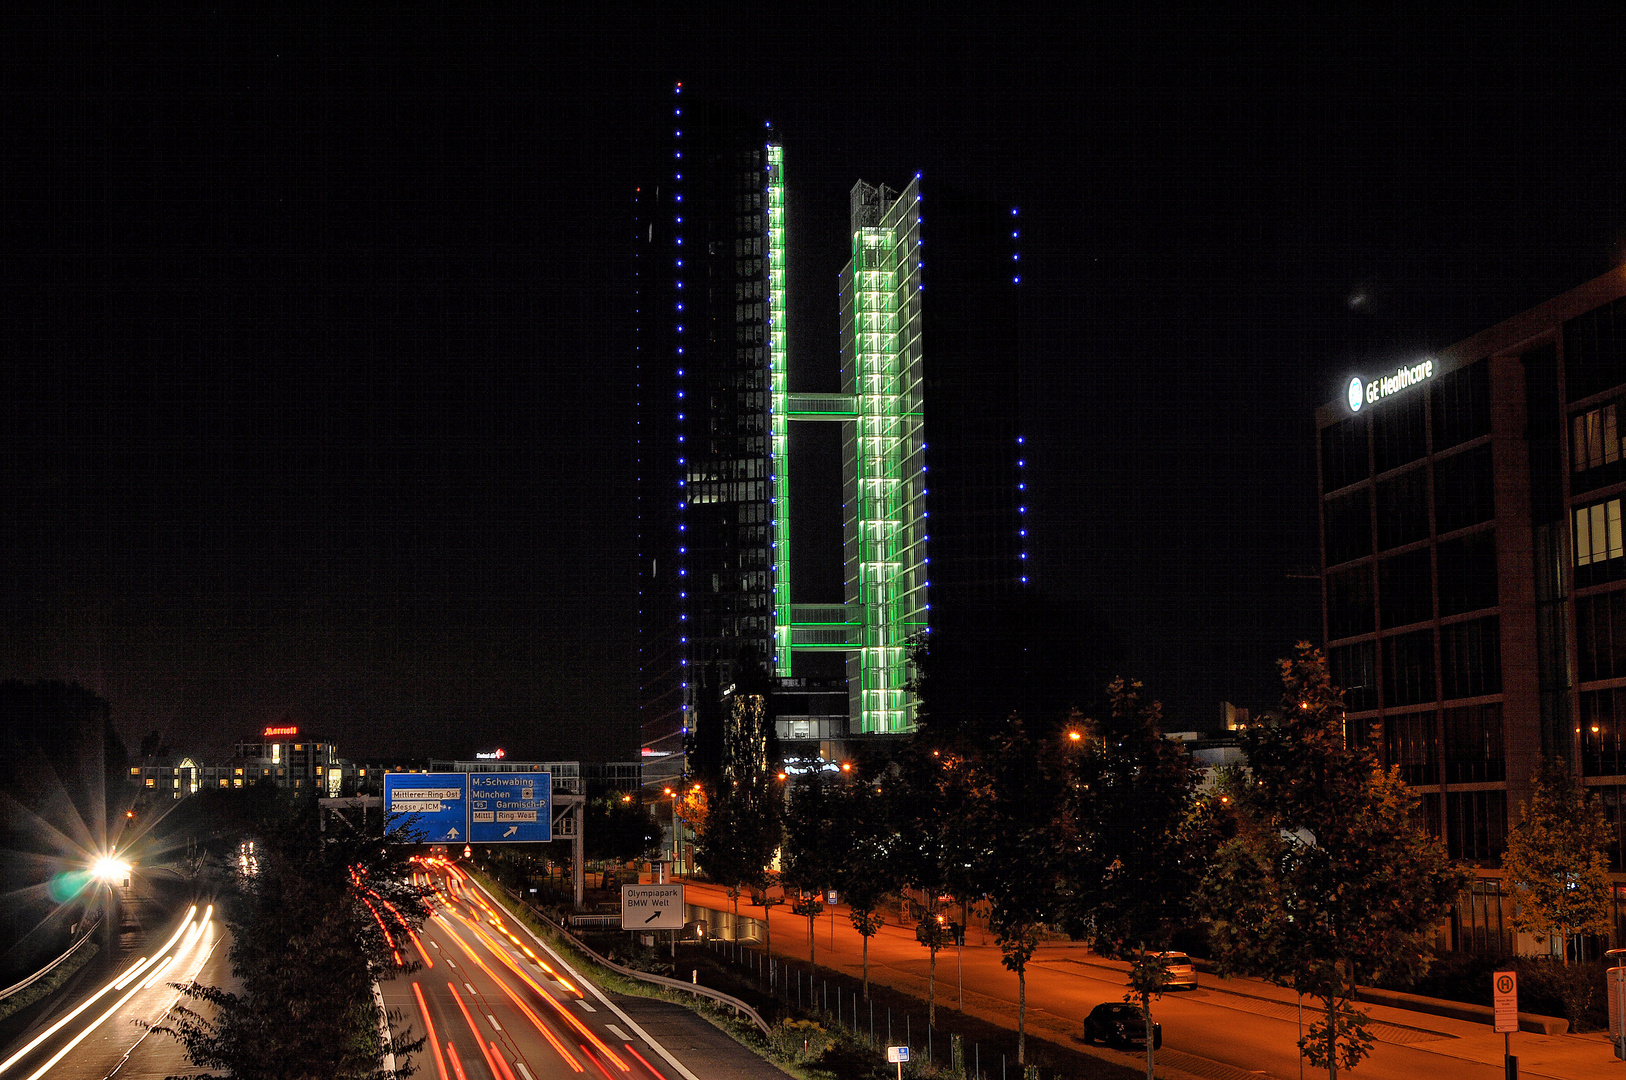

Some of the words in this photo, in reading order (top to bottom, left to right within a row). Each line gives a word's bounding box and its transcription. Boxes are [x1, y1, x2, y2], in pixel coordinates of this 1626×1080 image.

[1366, 380, 1380, 404] GE
[1380, 360, 1433, 398] Healthcare
[472, 777, 534, 787] M.-Schwabing
[428, 790, 444, 799] Ring
[472, 790, 511, 798] München
[498, 812, 515, 820] Ring
[627, 889, 678, 898] Olympiapark
[628, 899, 648, 907] BMW
[1501, 979, 1510, 990] H
